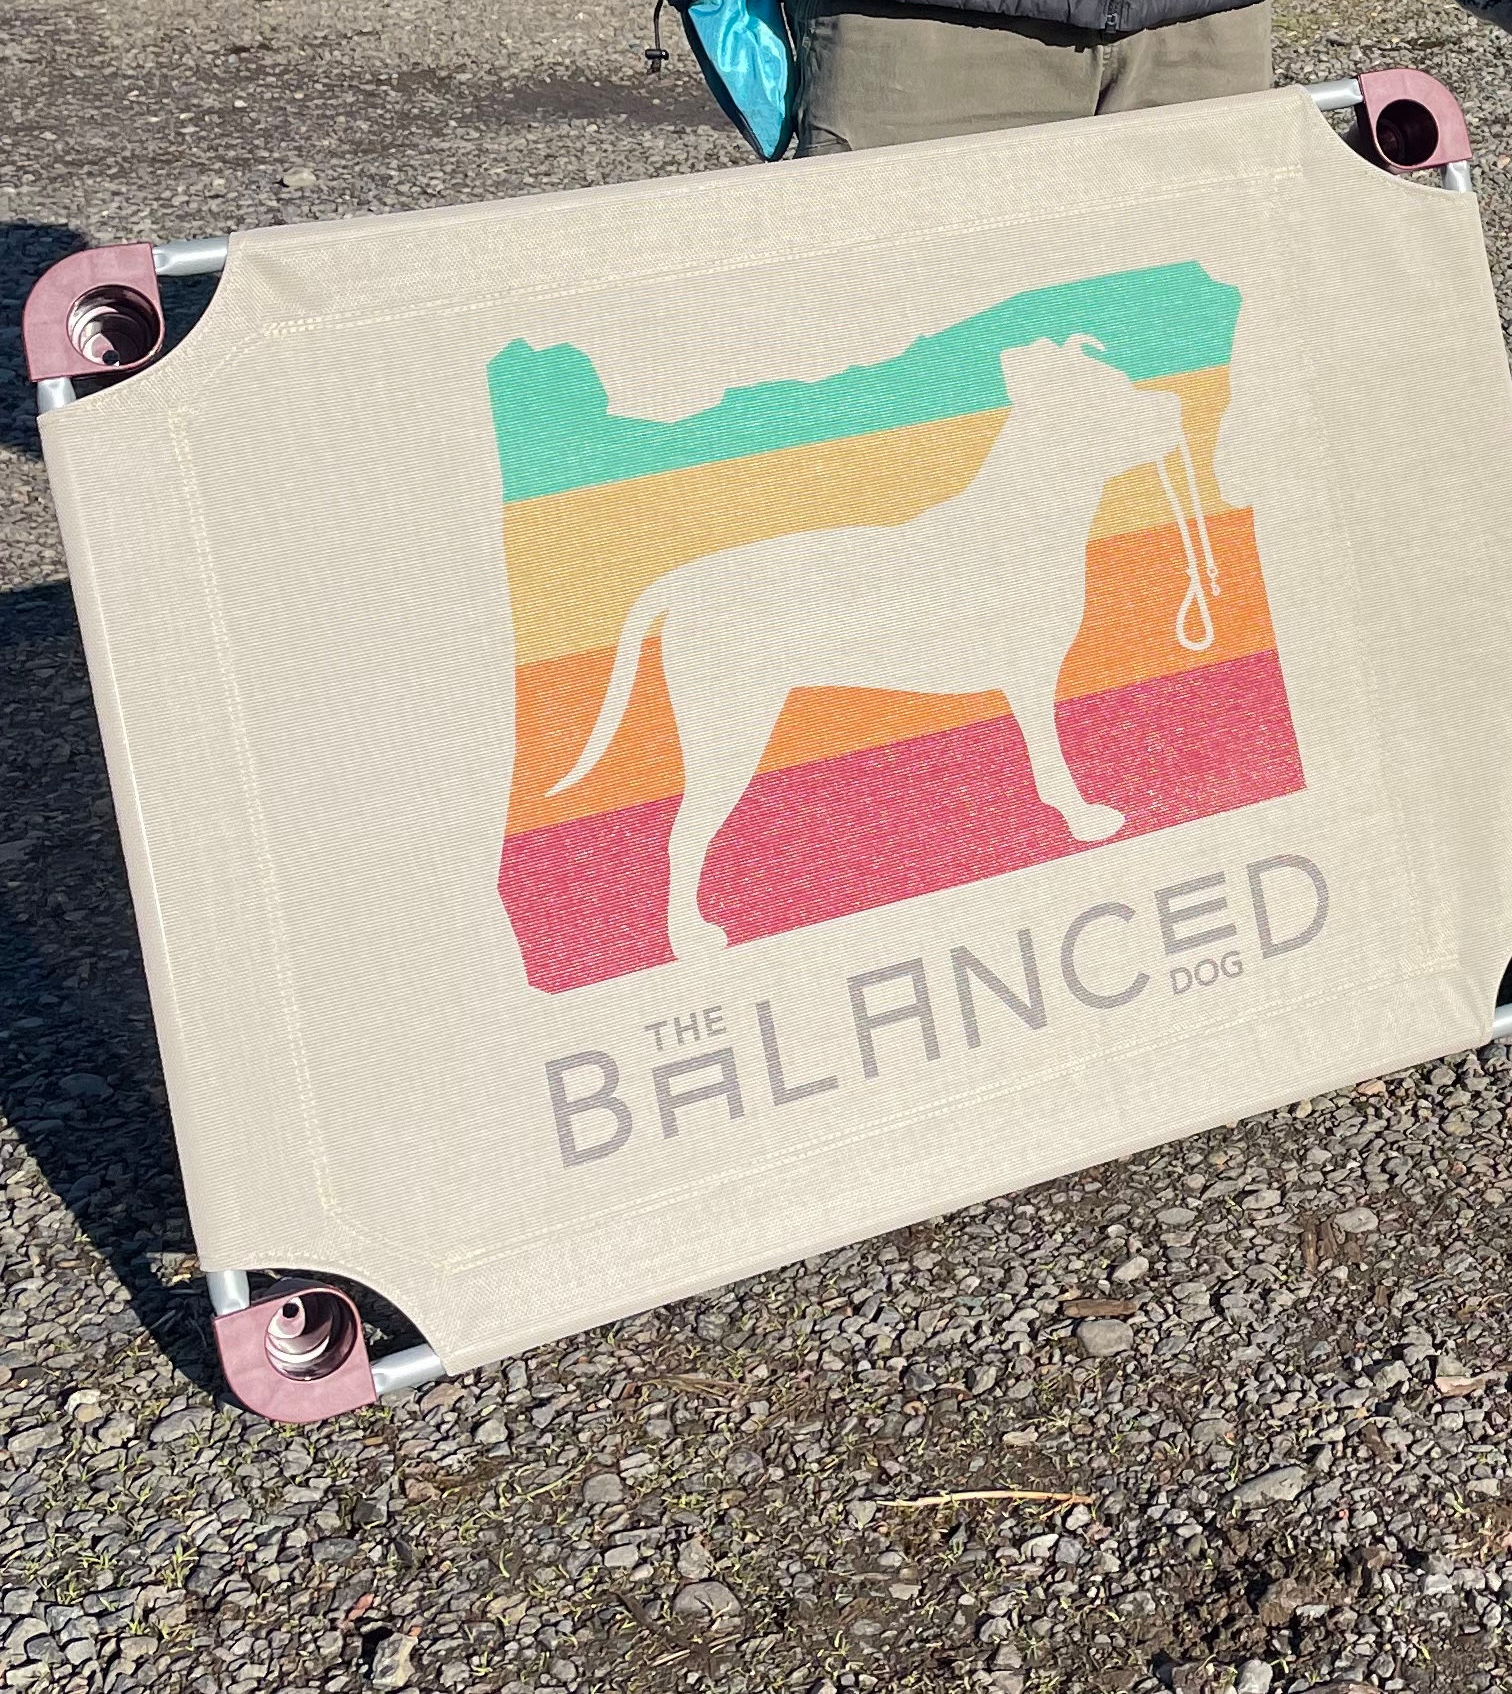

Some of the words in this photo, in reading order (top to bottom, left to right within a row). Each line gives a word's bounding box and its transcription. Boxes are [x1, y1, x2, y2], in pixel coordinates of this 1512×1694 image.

[1169, 950, 1244, 996] DOG
[543, 853, 1331, 1169] BALANCED
[644, 1005, 727, 1052] THE
